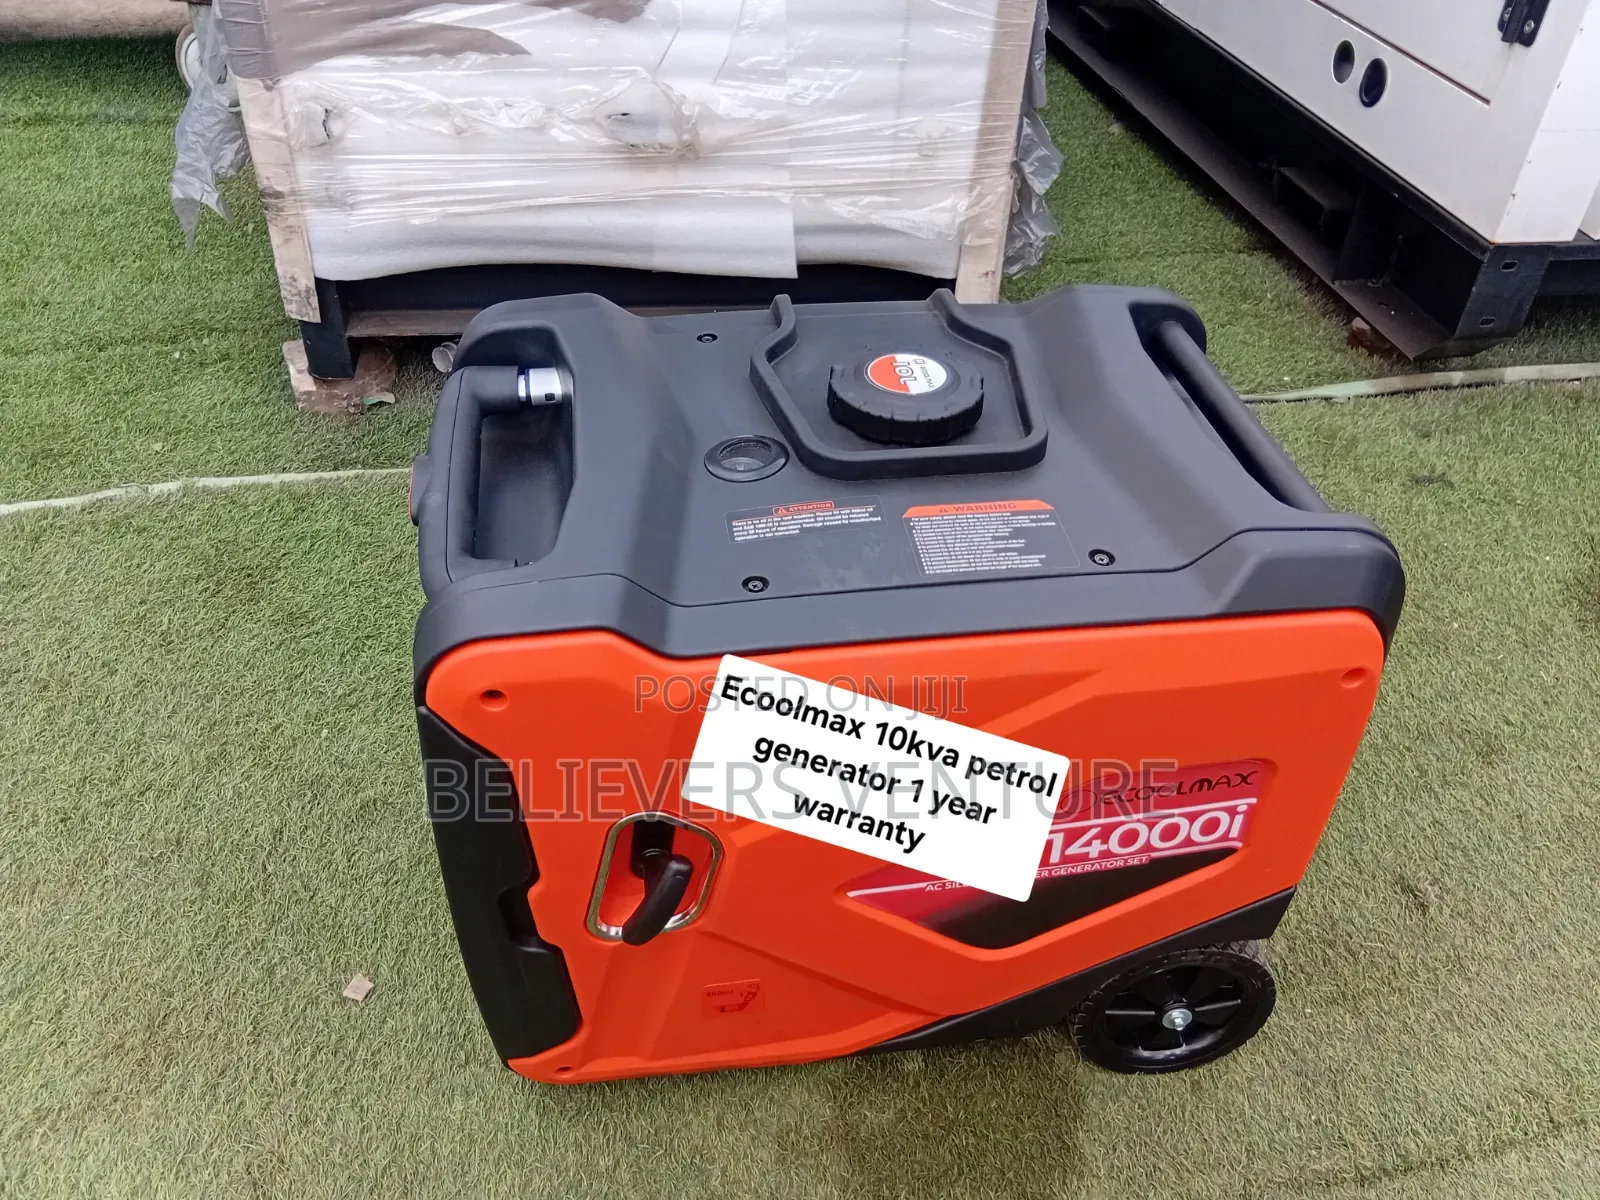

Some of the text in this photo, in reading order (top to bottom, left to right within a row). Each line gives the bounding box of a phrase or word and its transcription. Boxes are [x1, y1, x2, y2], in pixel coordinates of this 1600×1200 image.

[890, 361, 918, 386] 10L
[789, 502, 832, 512] ATTENTION
[952, 502, 1018, 512] WARNING
[1046, 803, 1249, 863] 14000i
[925, 883, 943, 892] AC
[1051, 859, 1125, 876] GENERATOR
[1126, 855, 1150, 866] SET
